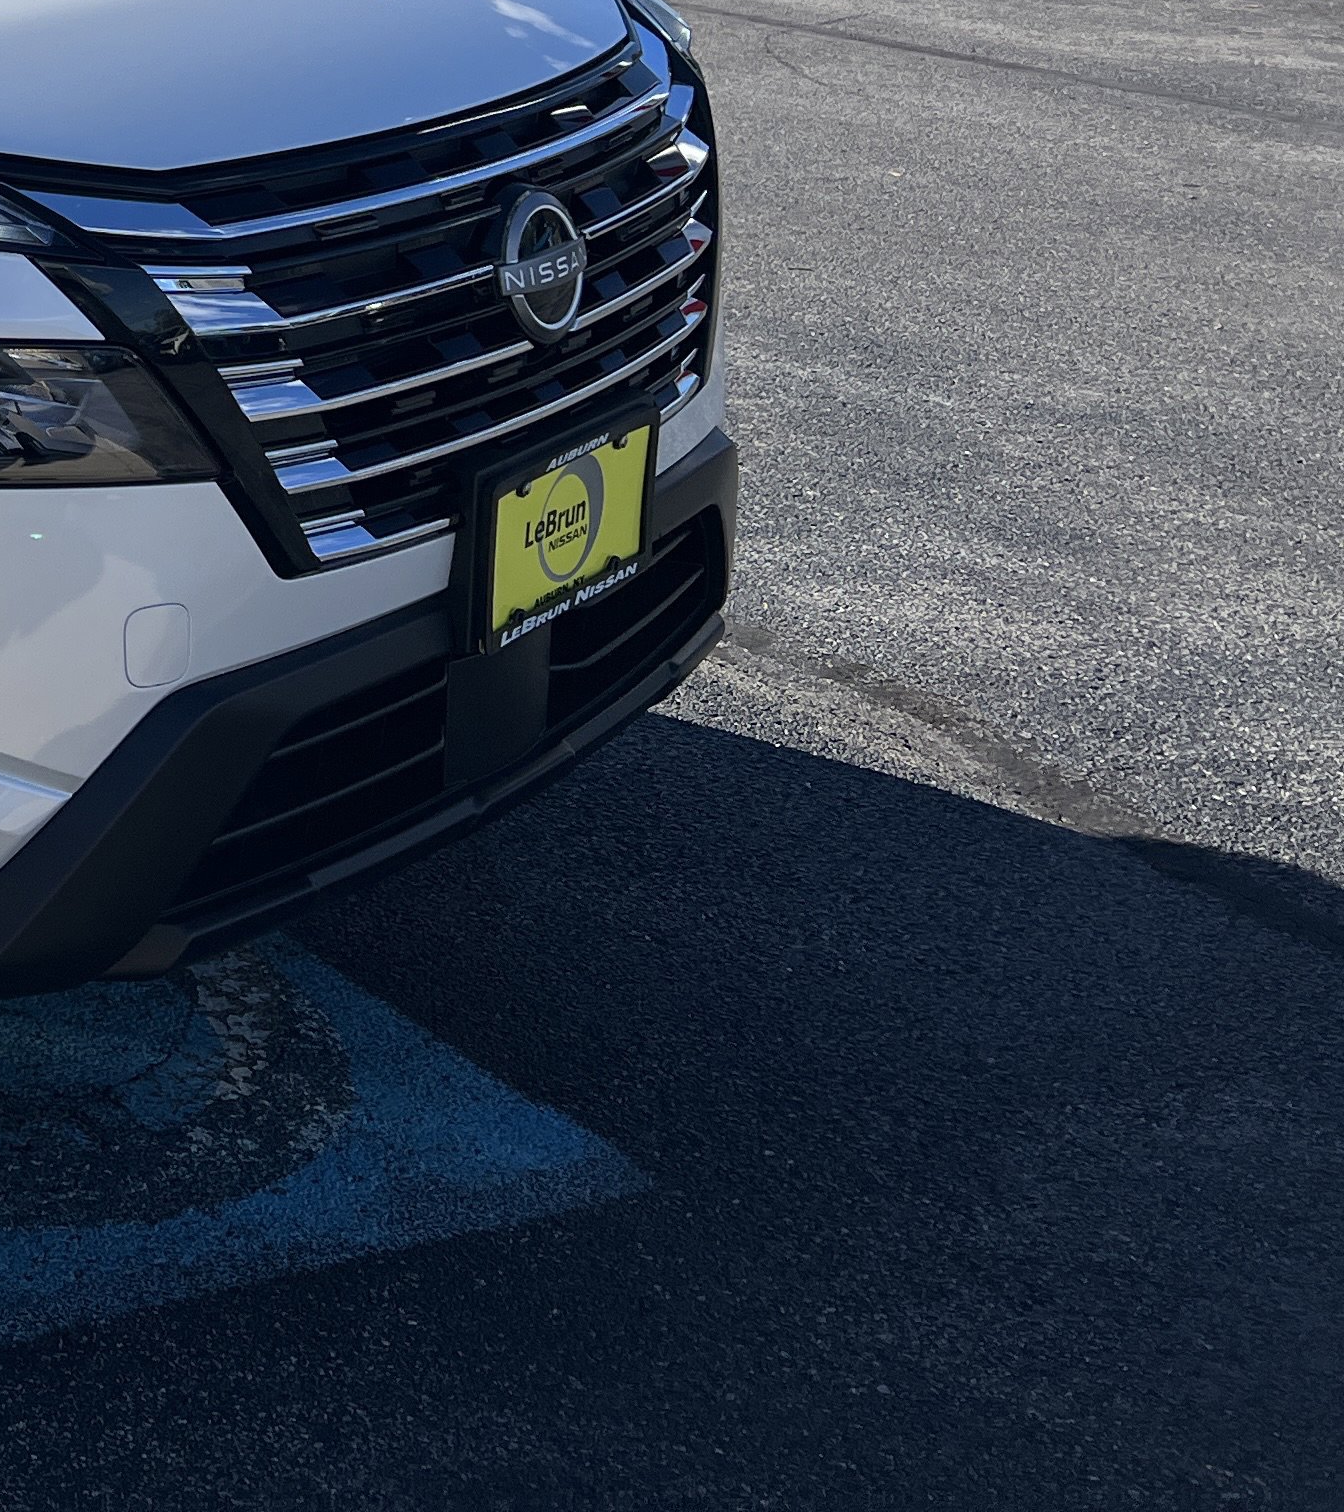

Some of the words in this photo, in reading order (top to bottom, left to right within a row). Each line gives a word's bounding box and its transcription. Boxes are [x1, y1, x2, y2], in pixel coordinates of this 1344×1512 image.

[545, 432, 610, 473] AUBURN
[524, 500, 586, 548] LeBrun
[547, 523, 588, 553] NISSAN
[574, 562, 638, 606] NISSAN
